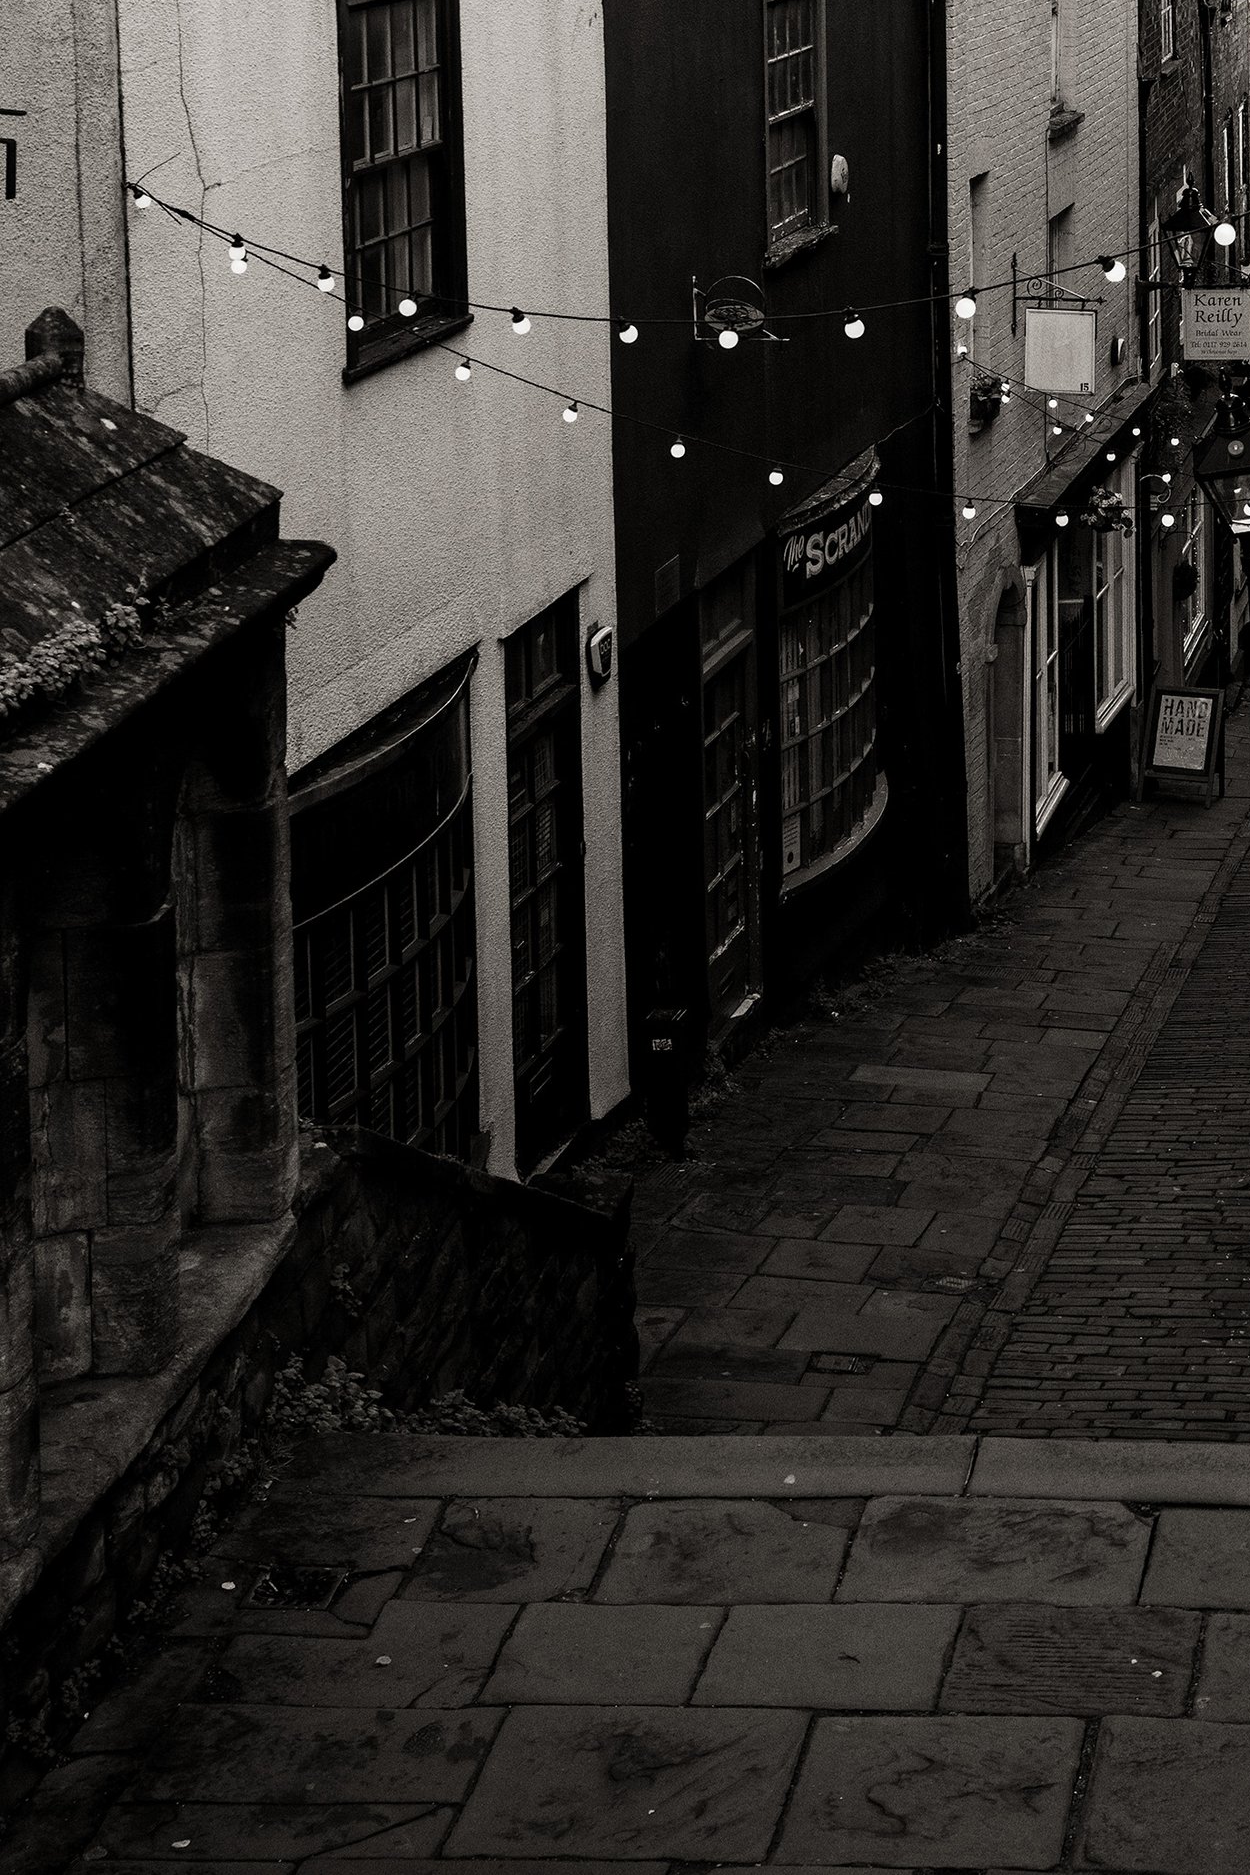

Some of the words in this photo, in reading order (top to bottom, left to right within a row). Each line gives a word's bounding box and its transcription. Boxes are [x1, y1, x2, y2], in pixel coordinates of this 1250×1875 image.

[1194, 294, 1242, 306] Karen
[1195, 308, 1242, 328] Reilly
[1195, 329, 1219, 337] Bridal
[1080, 382, 1089, 391] 15
[1164, 698, 1208, 718] HAND
[1161, 717, 1206, 737] MADE
